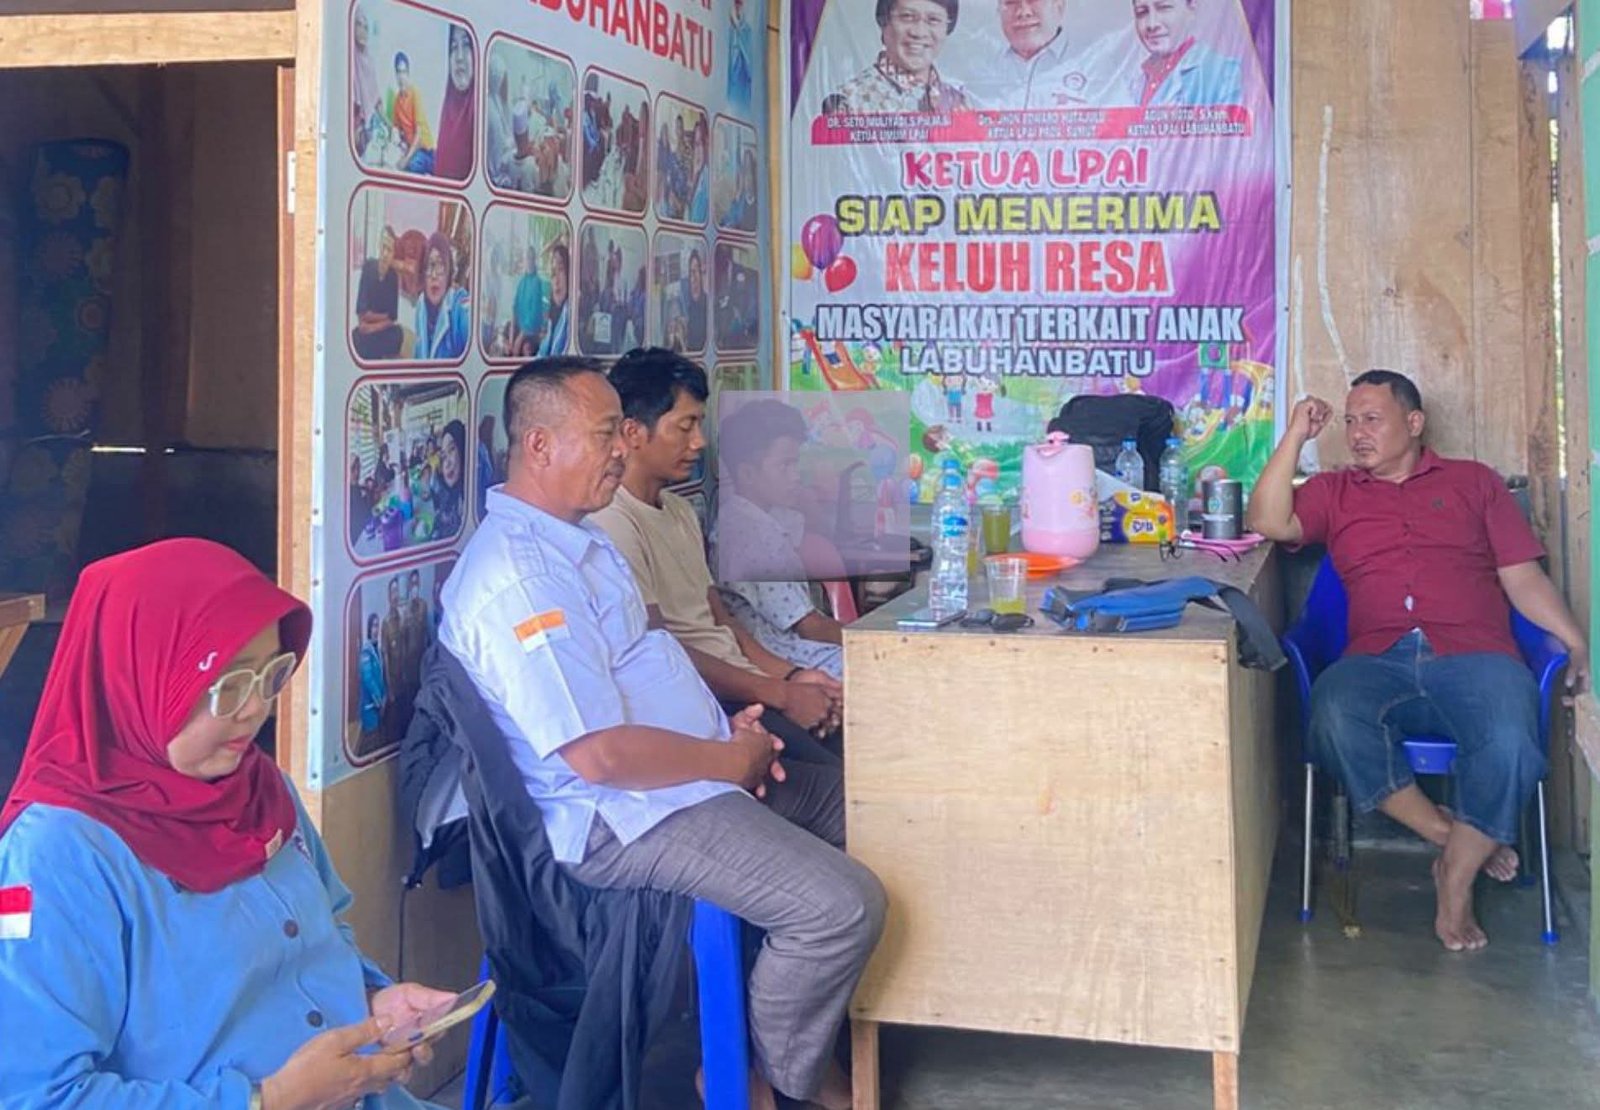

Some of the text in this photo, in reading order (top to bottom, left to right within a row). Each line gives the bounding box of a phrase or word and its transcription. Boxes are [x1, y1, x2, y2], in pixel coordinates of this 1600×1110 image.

[850, 130, 878, 142] KETUA
[879, 130, 907, 142] UMUM
[1127, 124, 1155, 136] KETUA
[903, 147, 1149, 189] KETUA LPAI
[836, 193, 1221, 235] SIAP MENERIMA
[884, 240, 1170, 293] KELUH RESA
[817, 304, 1246, 341] MASYARAKAT TERKAIT ANAK
[901, 345, 1154, 376] LABUHANBATU
